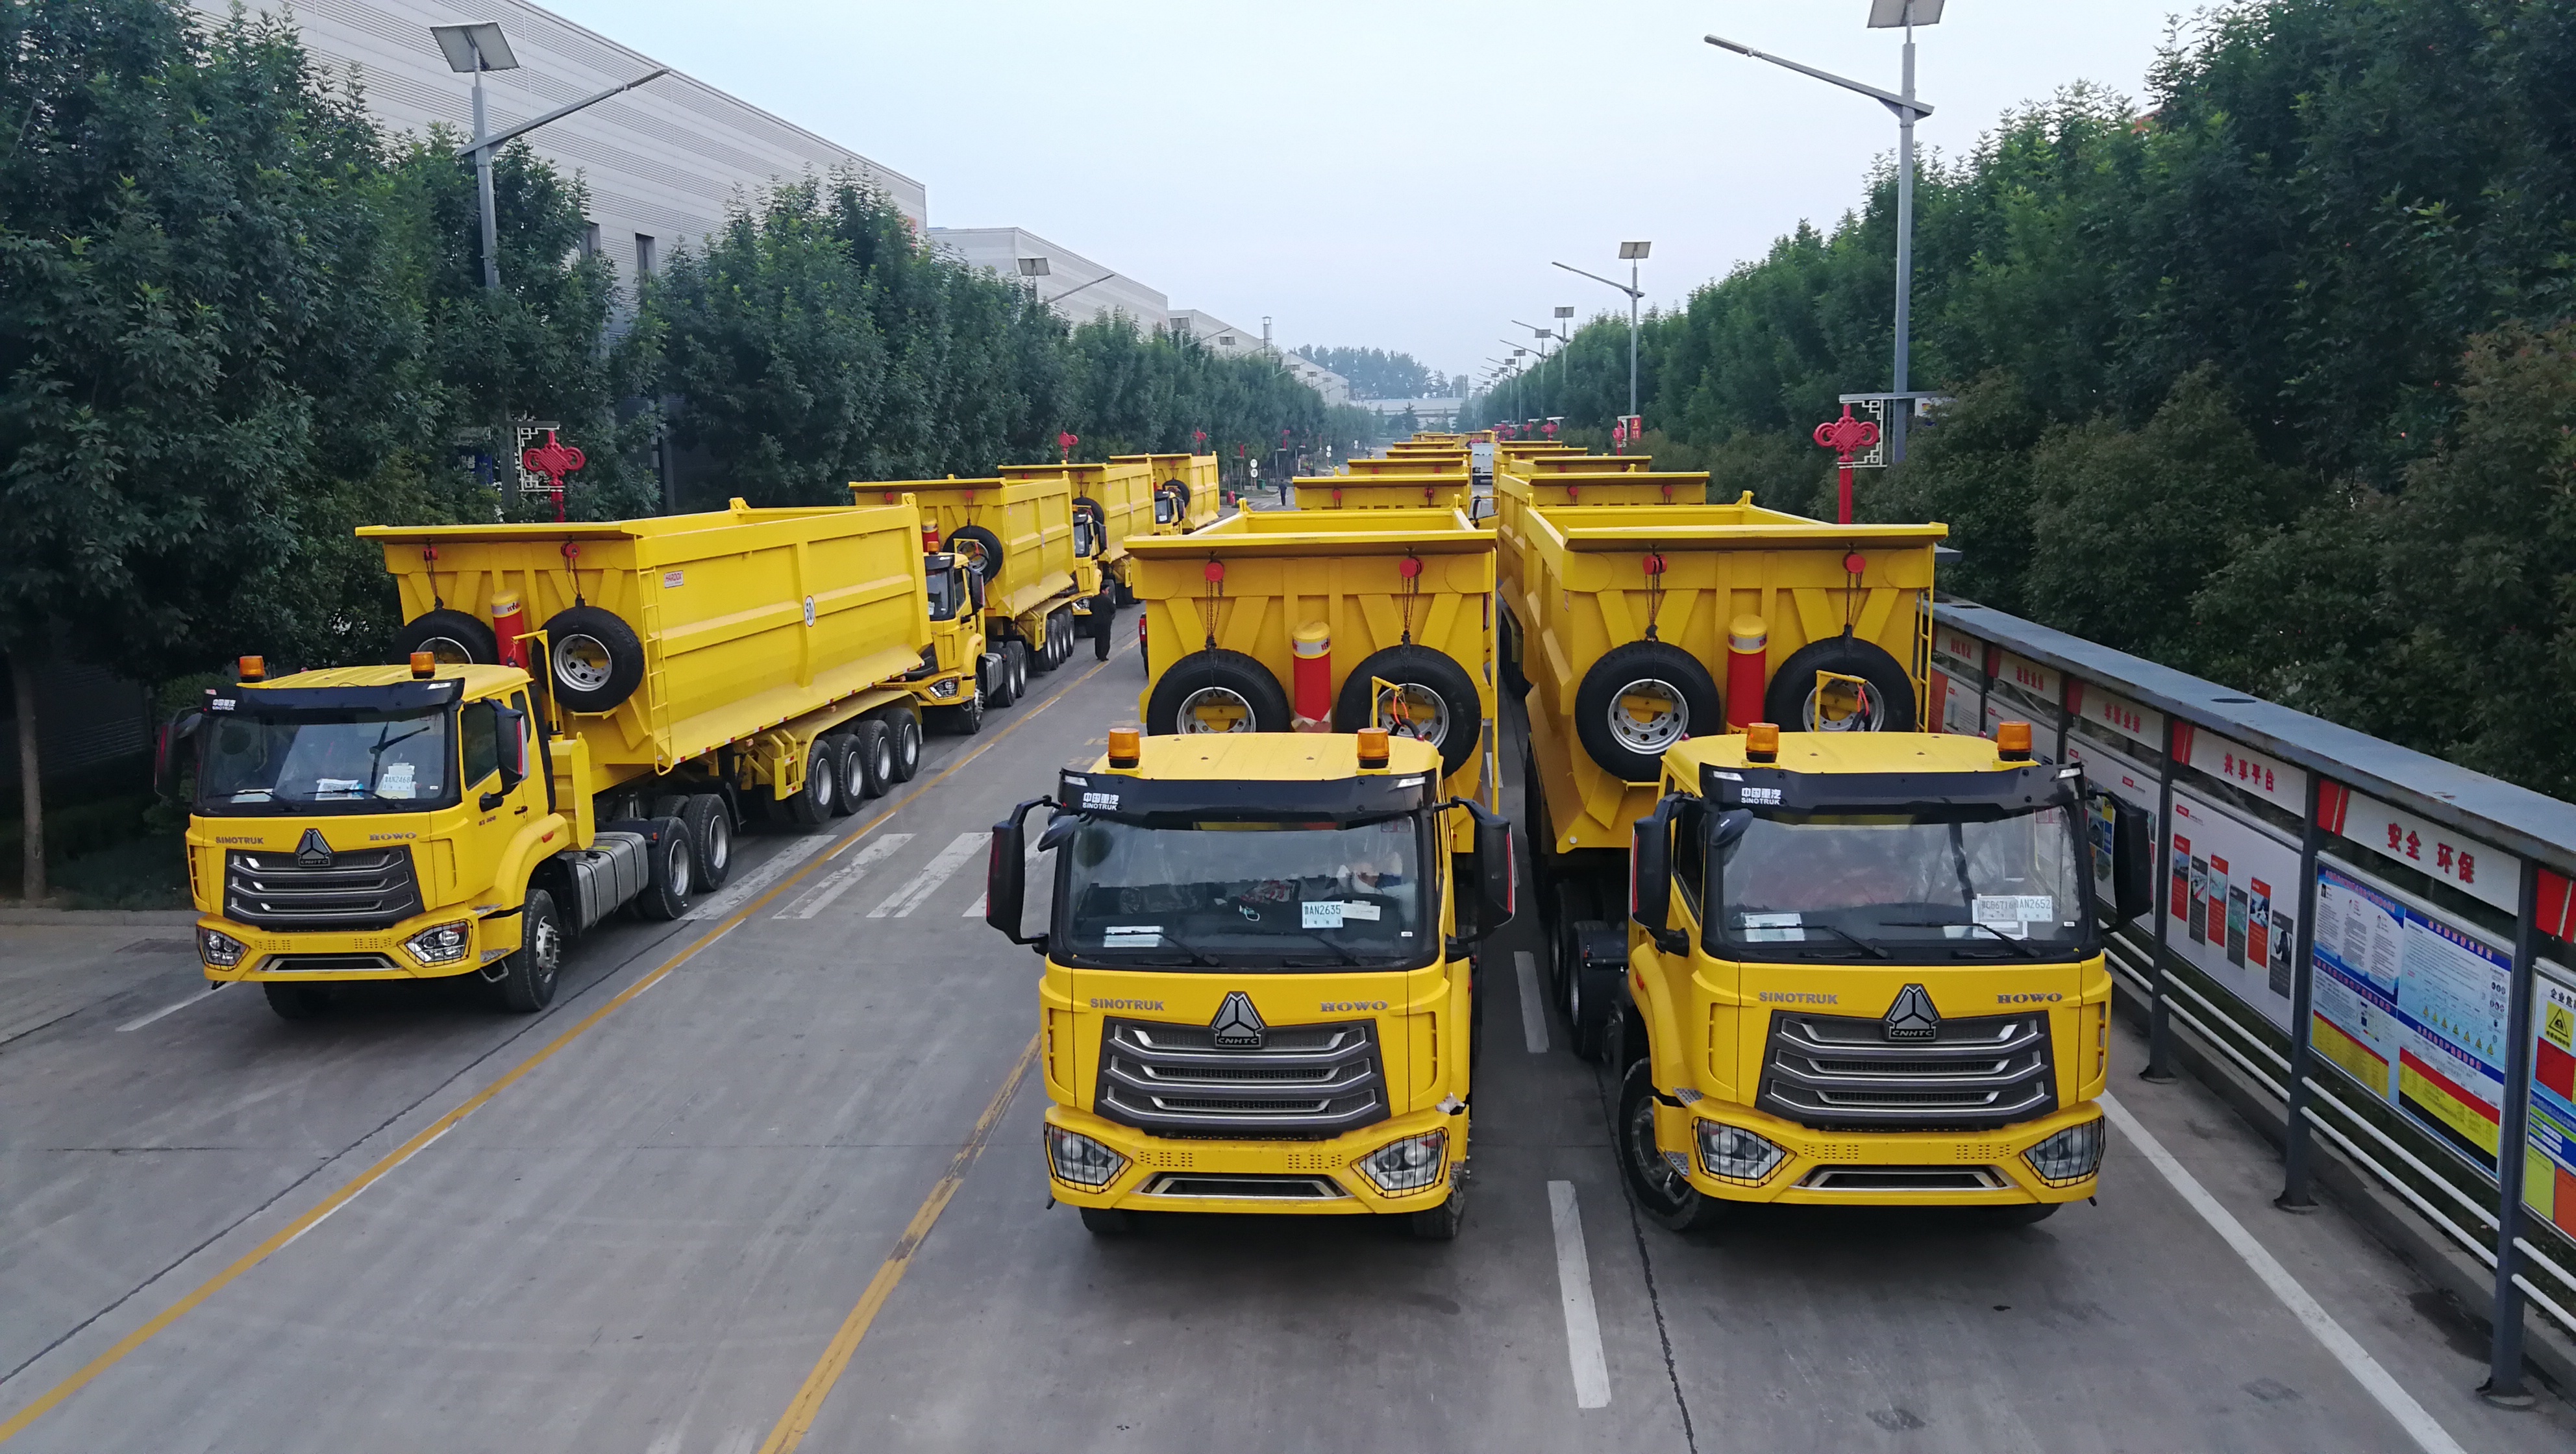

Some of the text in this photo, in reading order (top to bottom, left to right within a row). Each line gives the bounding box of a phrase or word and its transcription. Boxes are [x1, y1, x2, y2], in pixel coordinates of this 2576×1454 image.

[2224, 753, 2275, 793] 共享平台
[1084, 793, 1119, 804] 中国重汽
[1742, 787, 1781, 799] 中国重汽
[1082, 802, 1117, 811] SINOTRUK
[216, 836, 264, 844] SINOTRUK
[369, 832, 417, 841] HOWO
[2388, 823, 2474, 883] 安全 环保
[1759, 991, 1838, 1004] SINOTRUK
[1996, 992, 2062, 1004] HOWO
[1090, 998, 1165, 1011] SINOTRUK
[1320, 1000, 1388, 1012] HOWO
